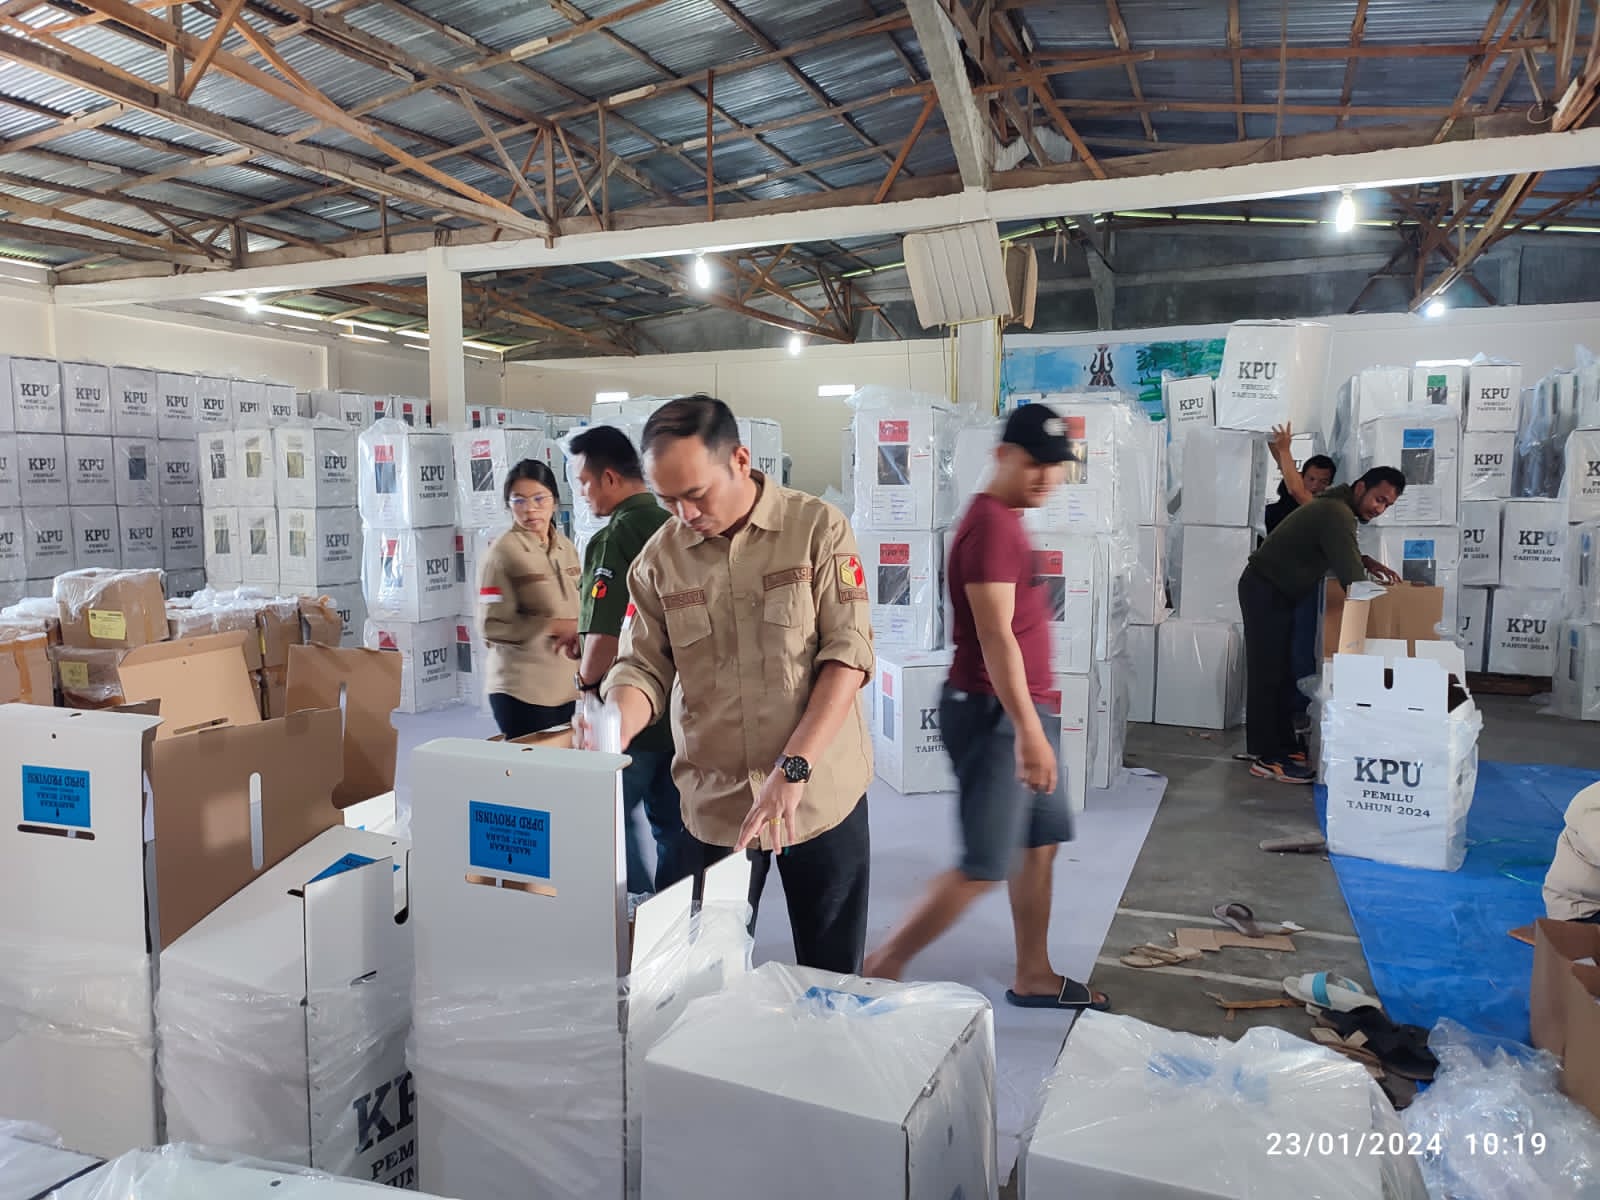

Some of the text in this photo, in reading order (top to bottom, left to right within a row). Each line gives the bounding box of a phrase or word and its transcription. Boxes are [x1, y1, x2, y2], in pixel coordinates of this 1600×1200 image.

[1238, 361, 1277, 380] KPU
[20, 383, 48, 397] KPU
[75, 387, 101, 401] KPU
[1480, 387, 1510, 400] KPU
[123, 391, 147, 404] KPU
[165, 395, 188, 407] KPU
[203, 398, 224, 410] KPU
[1179, 397, 1204, 411] KPU
[272, 405, 292, 417] KPU
[28, 458, 56, 471] KPU
[78, 458, 105, 471] KPU
[324, 455, 347, 470] KPU
[1473, 453, 1503, 465] KPU
[166, 462, 190, 473] KPU
[420, 465, 445, 481] KPU
[37, 530, 64, 543] KPU
[84, 529, 110, 542] KPU
[129, 527, 153, 540] KPU
[171, 526, 195, 538] KPU
[1463, 528, 1486, 543] PU
[1518, 530, 1559, 546] KPU
[325, 533, 350, 547] KPU
[426, 558, 449, 575] KPU
[1506, 618, 1547, 634] KPU
[423, 647, 448, 667] KPU
[1354, 756, 1424, 788] KPU
[1362, 789, 1414, 803] PEMILU
[1346, 799, 1431, 818] TAHUN 2024
[475, 809, 516, 827] PROVINSI
[519, 816, 544, 832] DPRD
